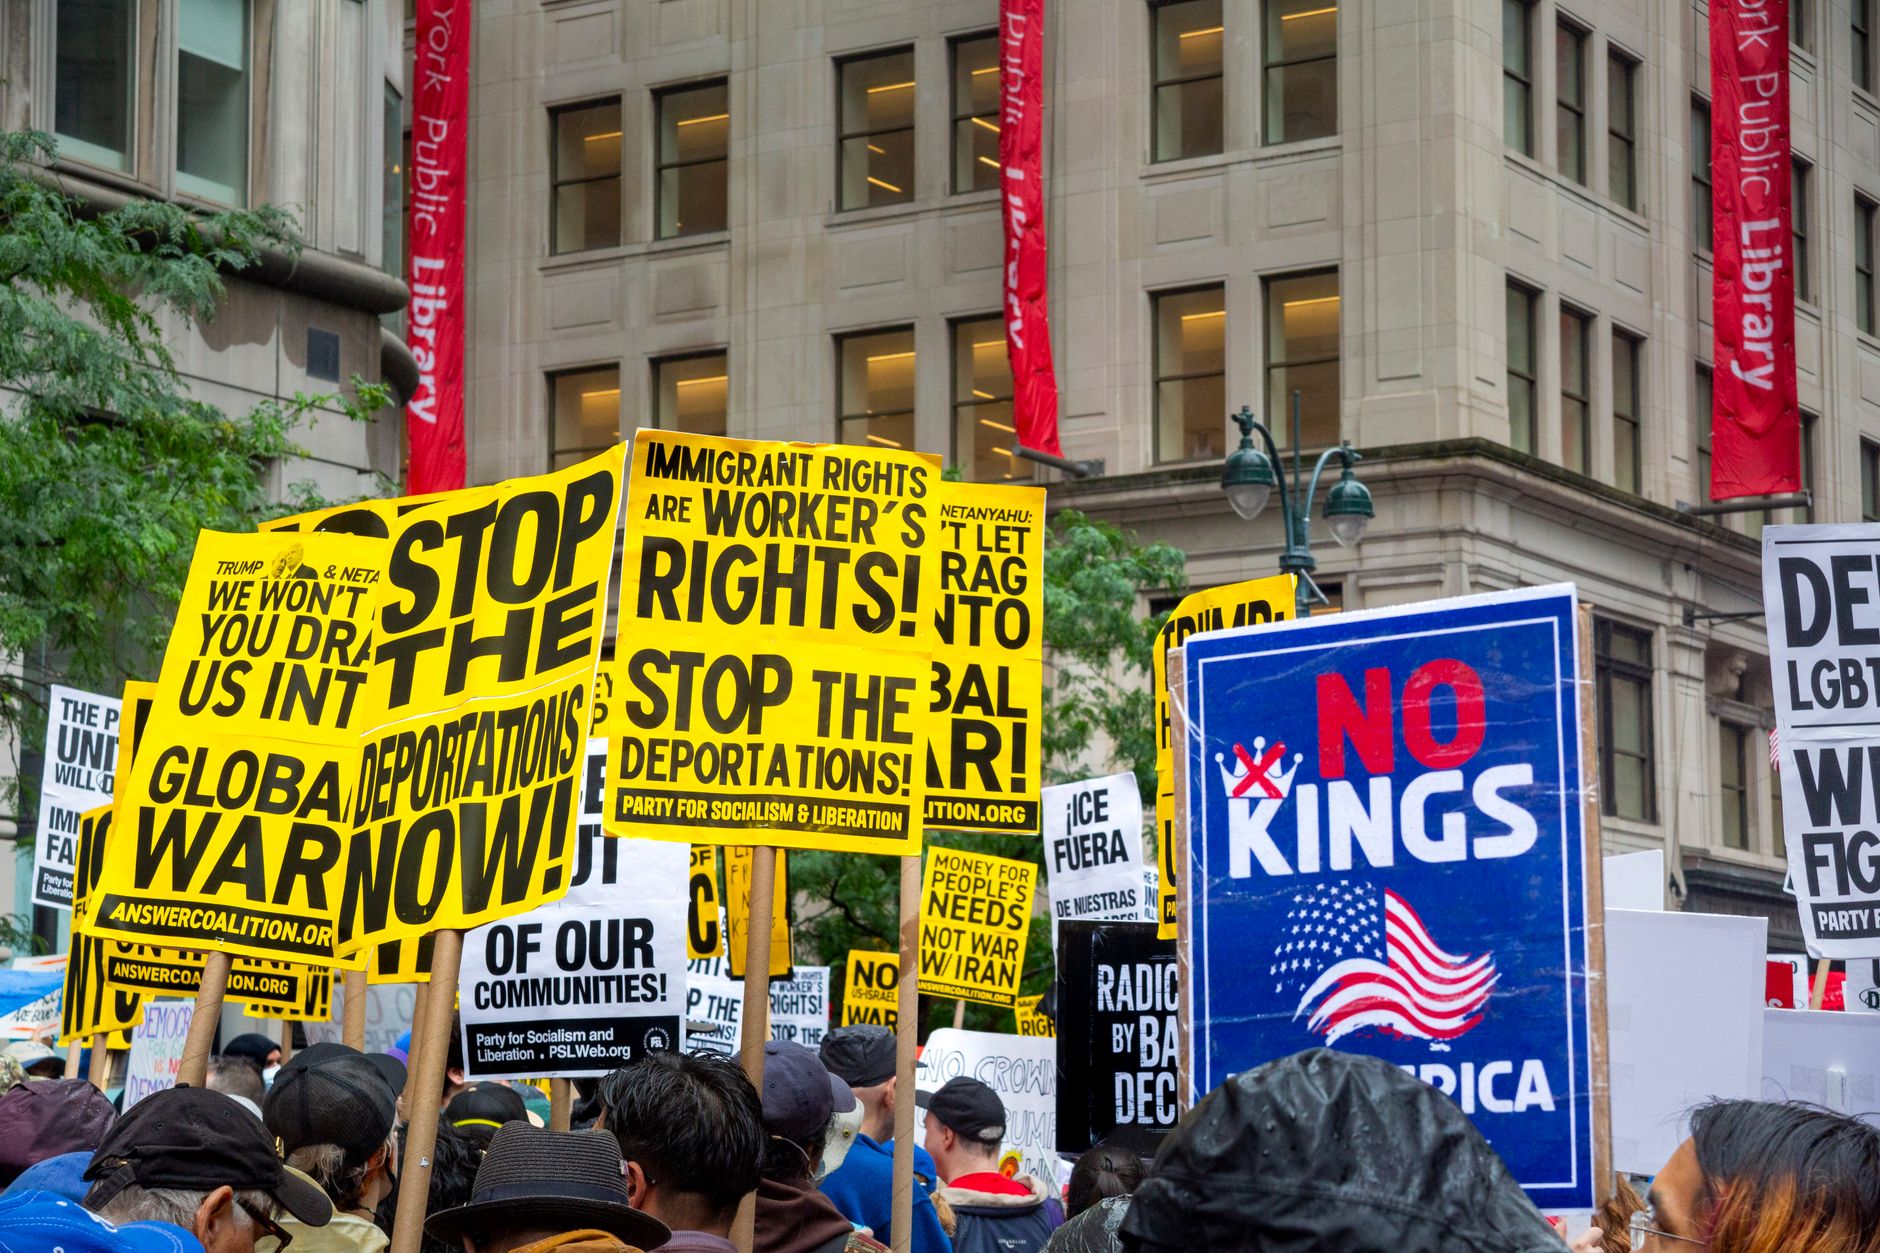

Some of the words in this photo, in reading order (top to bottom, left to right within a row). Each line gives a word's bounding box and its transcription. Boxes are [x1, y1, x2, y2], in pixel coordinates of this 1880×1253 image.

[1740, 72, 1781, 197] Public
[414, 114, 450, 236] Public
[1730, 218, 1782, 390] Library
[408, 256, 446, 424] Library
[646, 442, 814, 486] IMMIGRANT
[822, 456, 928, 499] RIGHTS
[645, 494, 692, 524] ARE
[703, 488, 927, 548] WORKER'S
[940, 504, 1032, 523] NETANYAHU:
[381, 470, 614, 634] STOP
[977, 524, 1030, 554] LET
[216, 561, 263, 574] TRUMP
[324, 565, 336, 579] &
[637, 536, 921, 638] RIGHTS!
[941, 550, 1027, 596] RAG
[208, 580, 254, 611] WE
[259, 580, 368, 618] WON'T
[199, 613, 280, 658] YOU
[374, 580, 598, 710] THE
[61, 698, 99, 727] THE
[178, 660, 253, 717] US
[260, 662, 368, 729] INT
[626, 648, 792, 736] STOP
[812, 670, 916, 744] THE
[1316, 658, 1486, 779] NO
[55, 763, 95, 791] WILL
[353, 684, 584, 830] DEPORTATIONS
[620, 736, 912, 796] DEPORTATIONS!
[622, 796, 674, 818] PARTY
[677, 799, 707, 820] FOR
[710, 800, 794, 822] SOCIALISM
[797, 804, 810, 823] &
[812, 804, 902, 832] LIBERATION
[1066, 788, 1108, 835] ¡ICE
[1228, 763, 1538, 879] KINGS
[134, 806, 342, 910] WAR
[338, 775, 574, 946] NOW!
[934, 854, 994, 876] MONEY
[998, 865, 1029, 882] FOR
[1054, 829, 1129, 873] FUERA
[43, 873, 62, 888] Party
[932, 872, 1027, 902] PEOPLE'S
[928, 891, 1024, 930] NEEDS
[1056, 899, 1072, 918] DE
[1074, 889, 1136, 915] NUESTRAS
[1817, 911, 1870, 931] PARTY
[485, 924, 542, 976] OF
[556, 918, 654, 971] OUR
[922, 924, 966, 952] NOT
[972, 932, 1019, 962] WAR
[474, 973, 667, 1010] COMMUNITIES!
[852, 988, 896, 1002] US-ISRAEL
[854, 960, 898, 990] NO
[1098, 963, 1178, 1012] RADIC
[708, 995, 741, 1022] THE
[770, 994, 822, 1015] RIGHTS!
[476, 1032, 506, 1047] Party
[508, 1031, 524, 1046] for
[526, 1029, 586, 1043] Socialism
[590, 1028, 614, 1042] and
[477, 1048, 534, 1062] Liberation
[549, 1044, 630, 1060] PSLWeb.org
[801, 1028, 822, 1044] THE
[1112, 1023, 1134, 1052] BY
[1139, 1016, 1179, 1068] BA
[920, 1049, 965, 1083] NO
[1115, 1072, 1176, 1124] DEC
